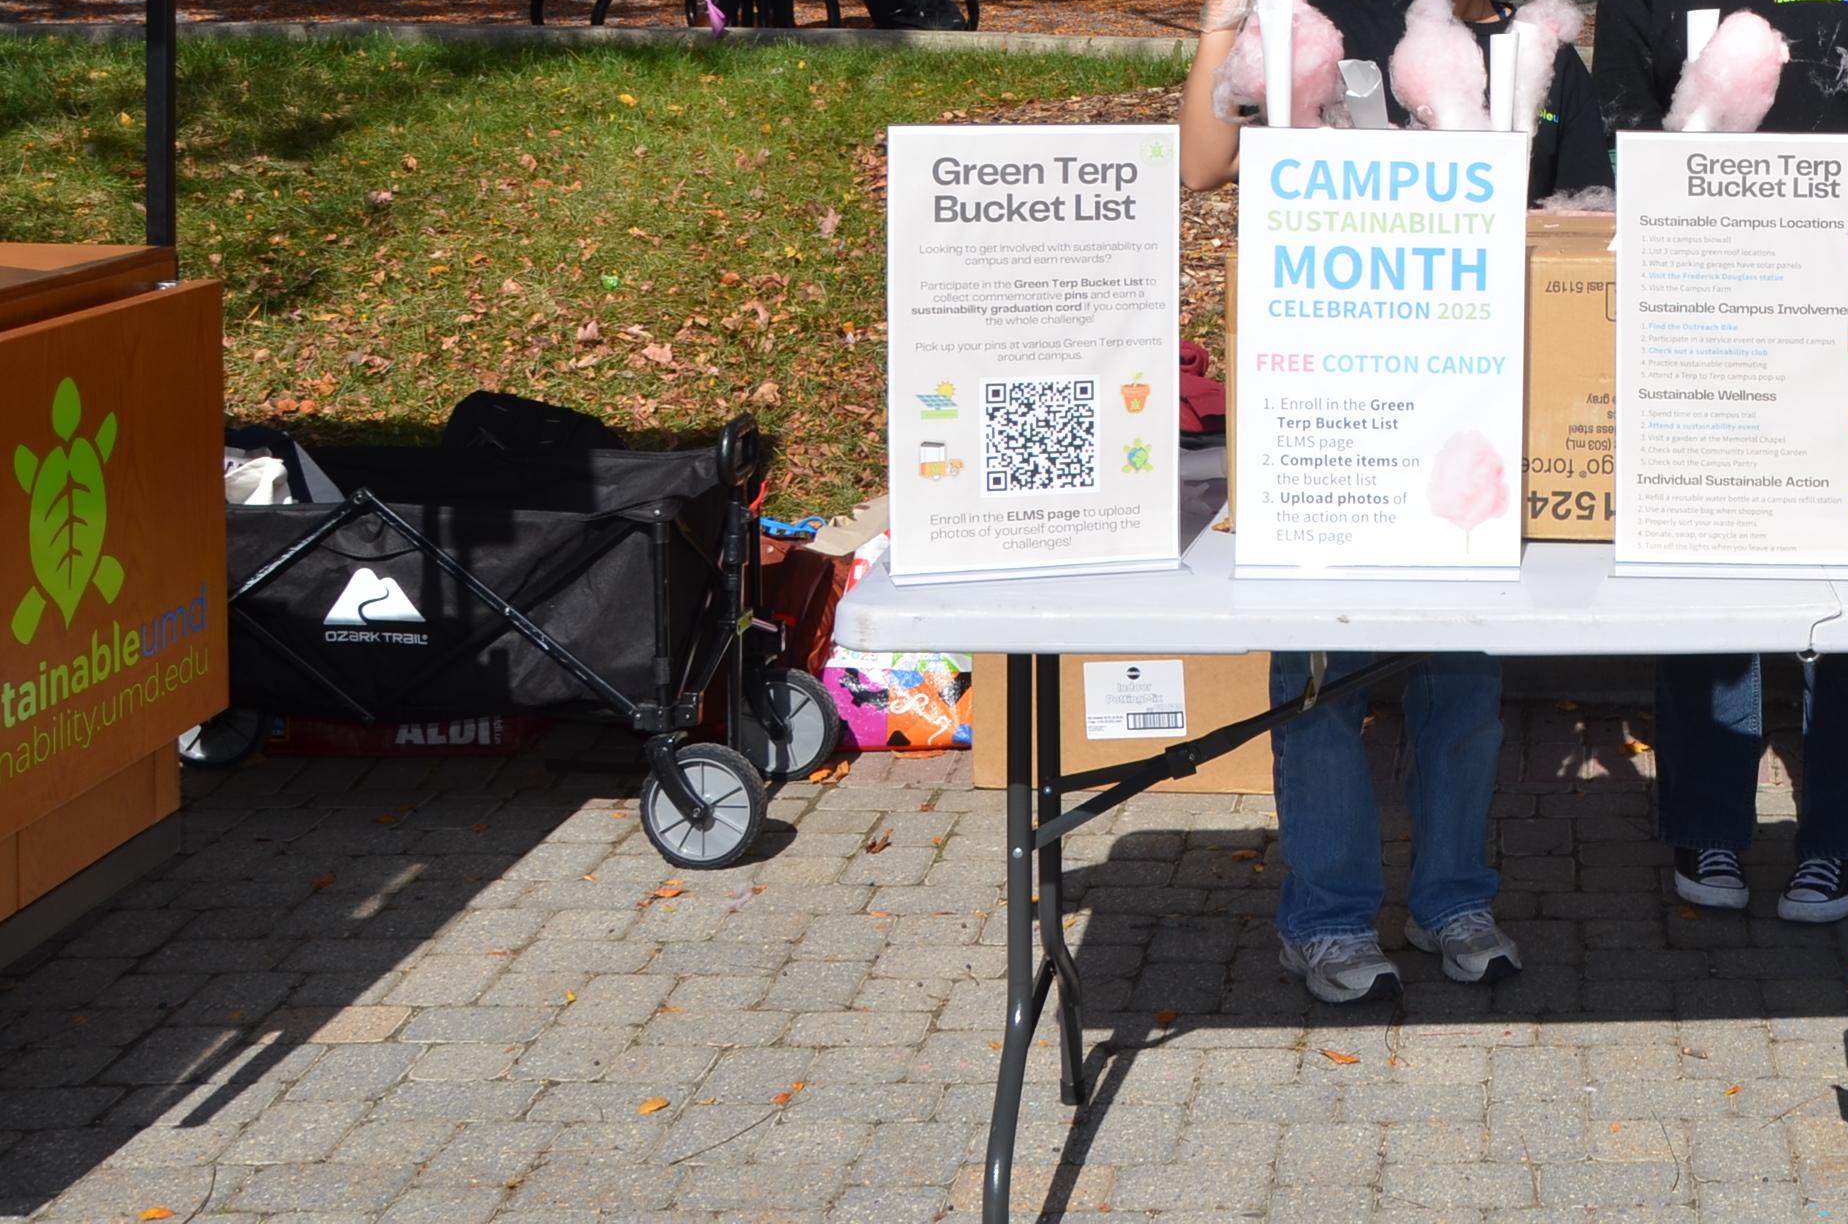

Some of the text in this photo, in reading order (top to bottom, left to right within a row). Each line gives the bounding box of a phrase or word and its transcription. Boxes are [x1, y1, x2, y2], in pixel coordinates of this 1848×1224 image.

[932, 156, 1138, 191] Green Terp
[1686, 152, 1842, 182] Green Terp
[1270, 159, 1494, 202] CAMPUS
[1687, 175, 1841, 199] Bucket List
[934, 193, 1136, 222] Bucket List
[1267, 210, 1495, 234] SUSTAINABILITY
[1639, 214, 1844, 231] Sustainable Campus Locations
[919, 241, 1158, 256] Looking to get involved with sustainability on
[964, 253, 1112, 266] campus and earn rewards?
[1274, 245, 1487, 290] MONTH
[920, 276, 1156, 293] Participate in the Green Terp Bucket List to
[1545, 280, 1584, 293] 51197
[932, 288, 1144, 301] collect commemorative pins and earn a
[911, 300, 1165, 316] sustainability graduation cord if you complete
[1268, 299, 1490, 319] CELEBRATION 2025
[1639, 300, 1715, 314] Sustainable
[1718, 301, 1774, 318] Campus
[985, 313, 1094, 326] the whole challenge!
[914, 336, 1162, 353] Pick up your pins at various Green Terp events
[996, 350, 1082, 362] around campus.
[1256, 353, 1506, 374] FREE COTTON CANDY
[1638, 387, 1776, 402] Sustainable Wellness
[1280, 397, 1322, 411] Enroll
[1326, 397, 1338, 412] in
[1343, 397, 1366, 412] the
[1370, 397, 1414, 412] Green
[1276, 415, 1398, 433] Terp Bucket List
[1277, 434, 1354, 452] ELMS page
[1565, 437, 1612, 452] (503 mL)
[1280, 453, 1352, 471] Complete
[1356, 453, 1398, 468] items
[1401, 457, 1419, 468] on
[1522, 457, 1575, 478] force
[1276, 472, 1376, 486] the bucket list
[1636, 472, 1829, 488] Individual Sustainable Action
[1280, 490, 1333, 508] Upload
[1337, 490, 1389, 509] photos
[1393, 491, 1406, 505] of
[930, 504, 1140, 525] Enroll in the ELMS page to upload
[1276, 509, 1396, 524] the action on the
[930, 518, 1140, 542] photos of yourself completing the
[1276, 527, 1352, 546] ELMS page
[1002, 536, 1072, 551] challenges!
[394, 717, 492, 745] ALDI
